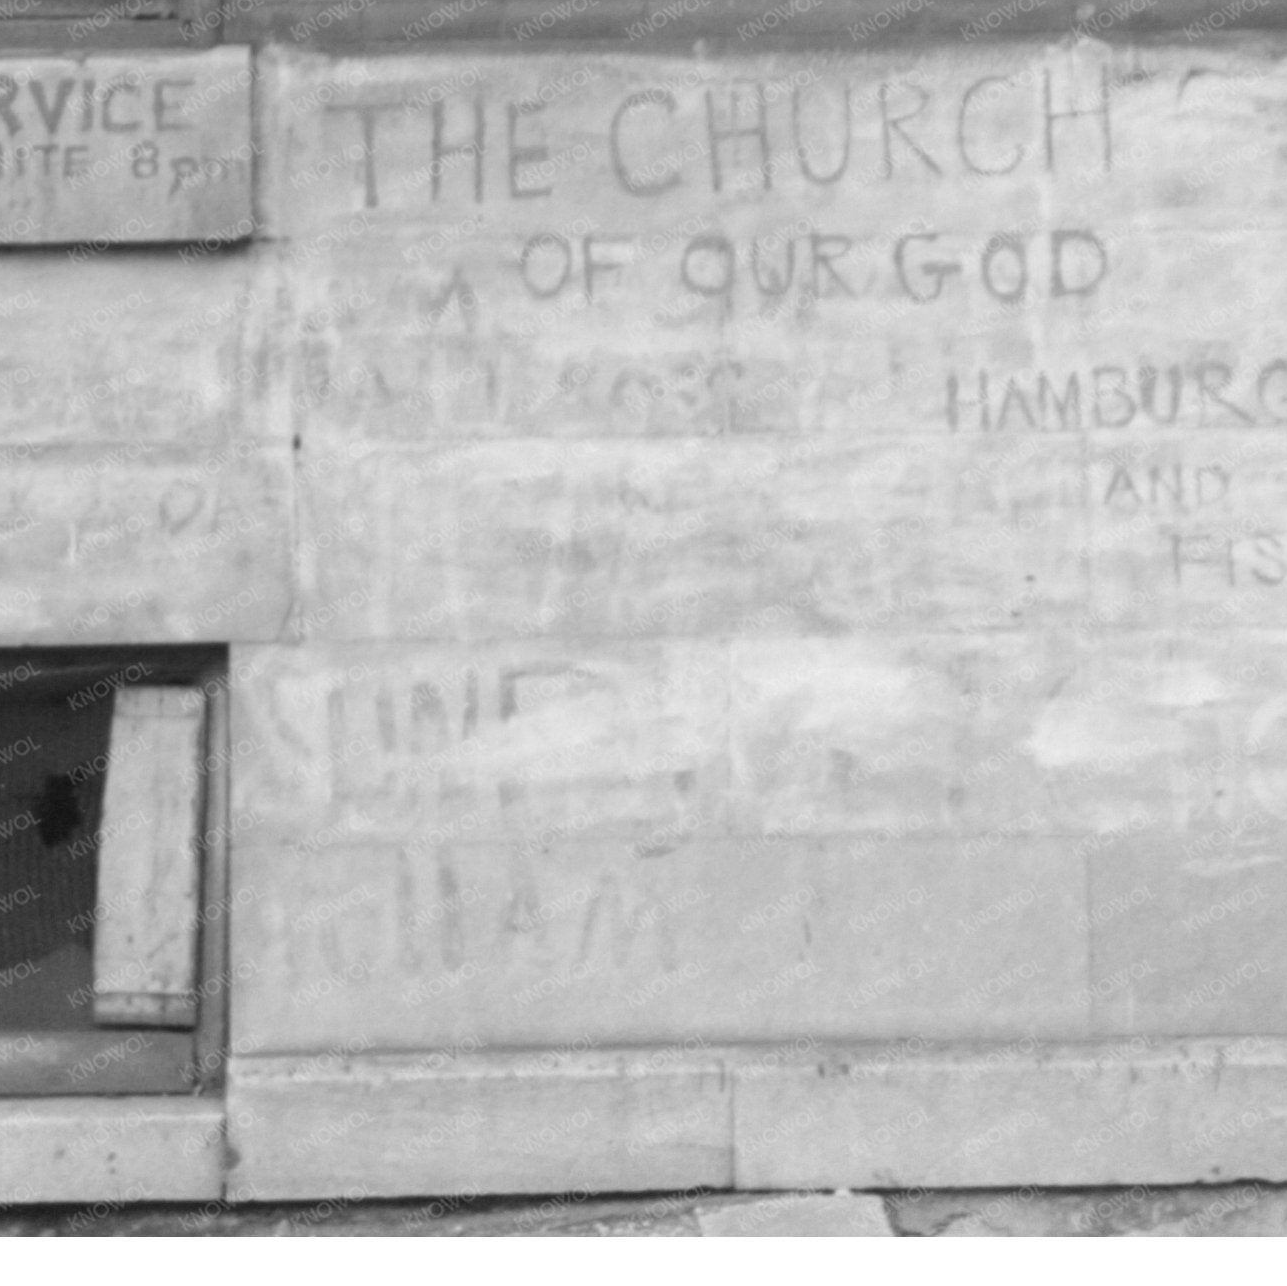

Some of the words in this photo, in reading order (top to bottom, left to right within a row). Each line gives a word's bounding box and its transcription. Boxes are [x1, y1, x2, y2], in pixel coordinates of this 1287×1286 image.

[321, 93, 554, 210] THE
[607, 60, 1113, 200] CHURCH
[518, 231, 634, 304] OF
[679, 231, 858, 302] OUR
[892, 227, 1110, 304] GOD
[1103, 462, 1232, 507] AND
